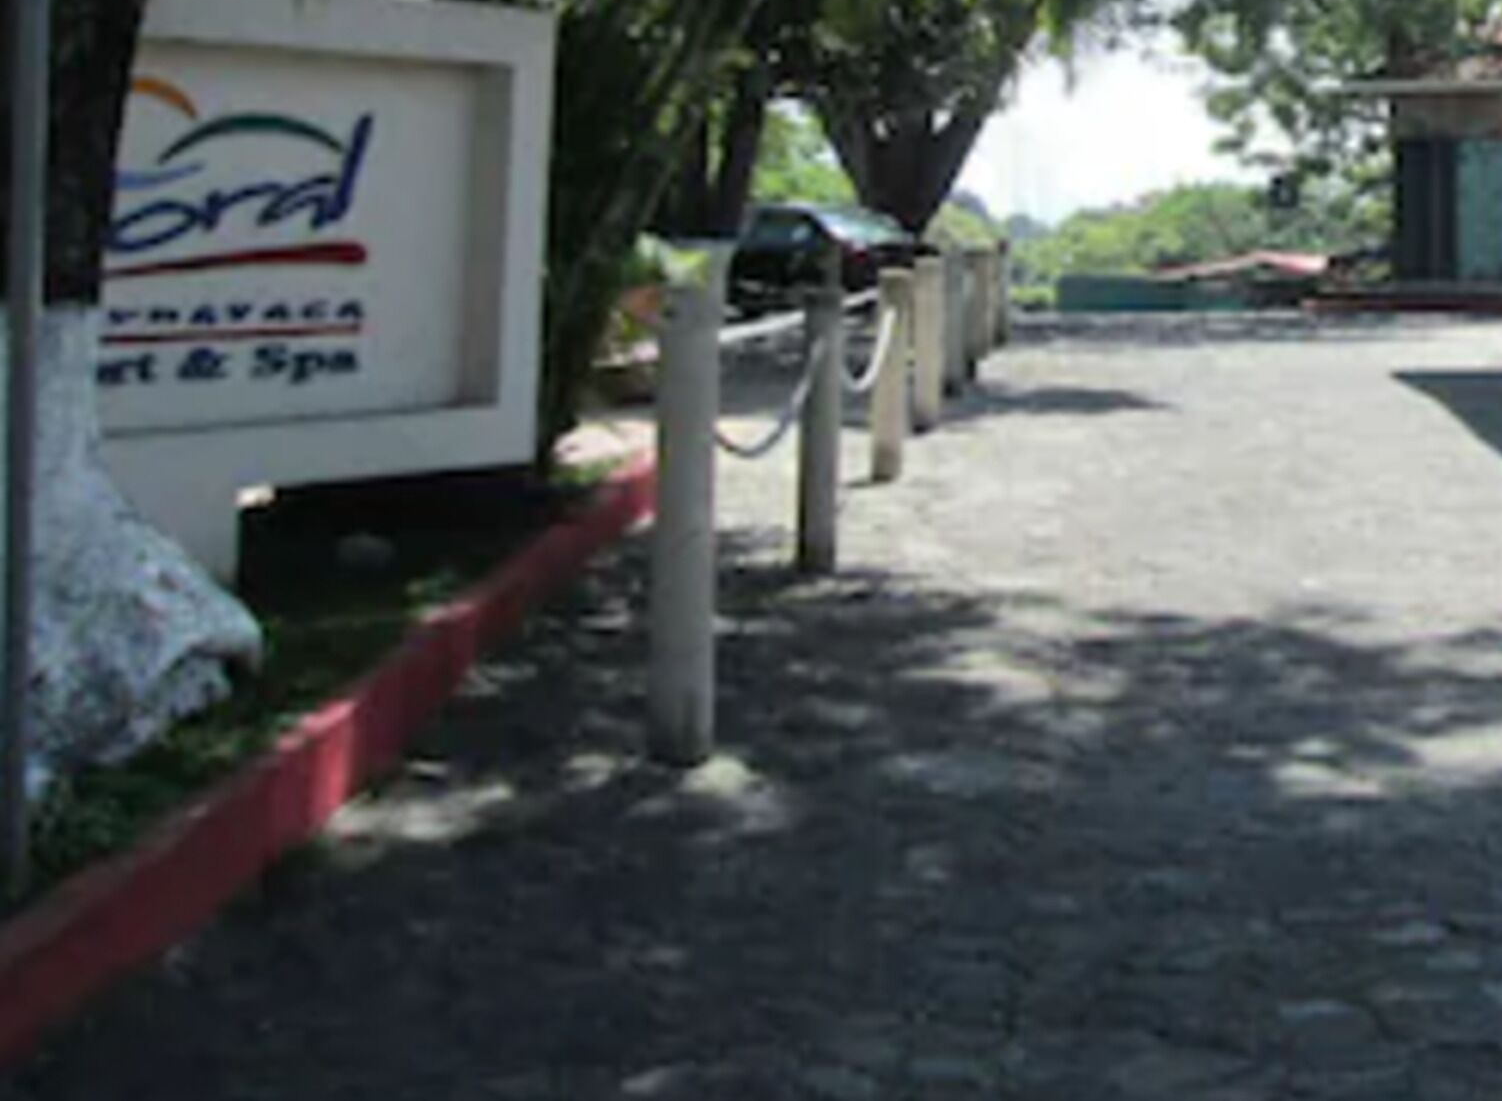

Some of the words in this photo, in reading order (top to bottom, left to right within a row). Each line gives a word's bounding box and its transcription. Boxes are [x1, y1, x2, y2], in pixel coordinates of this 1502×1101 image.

[106, 110, 372, 252] oral
[177, 347, 231, 381] &
[250, 345, 358, 384] Spa
